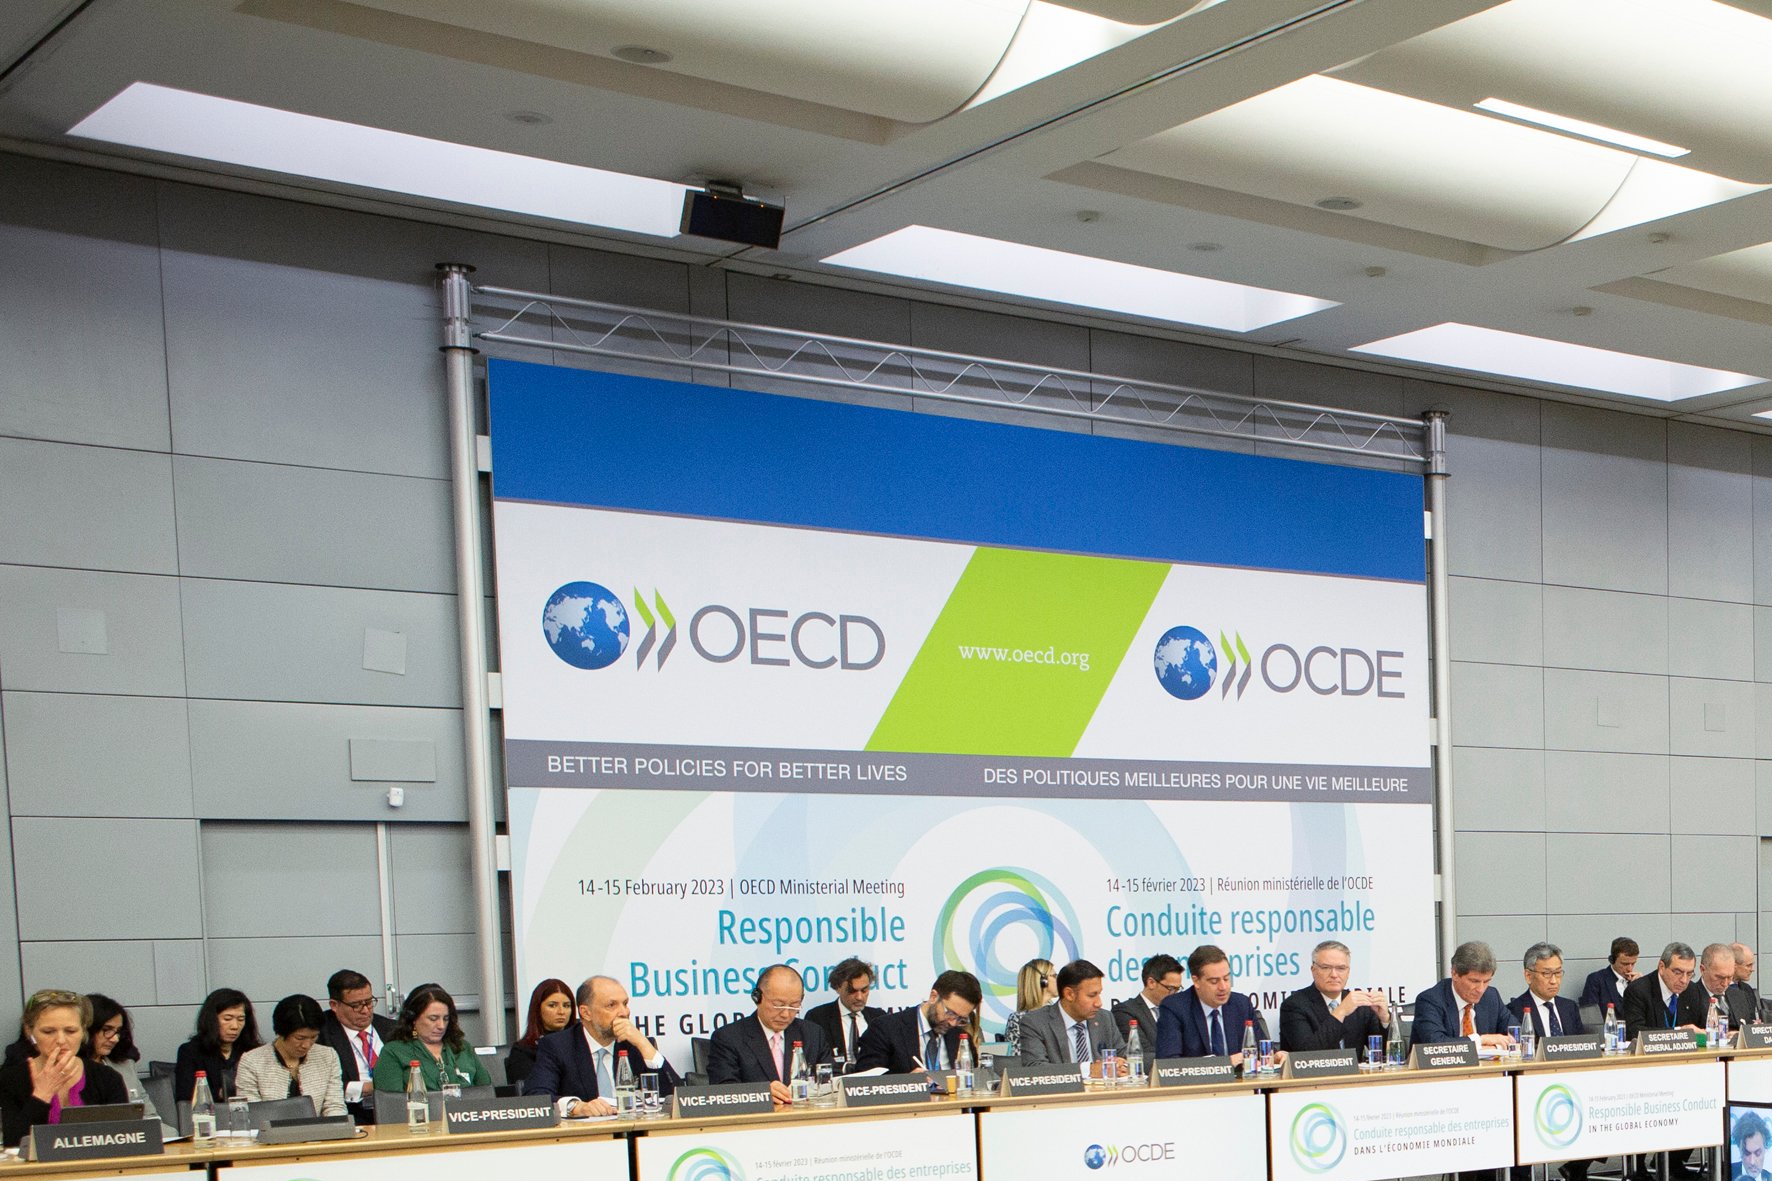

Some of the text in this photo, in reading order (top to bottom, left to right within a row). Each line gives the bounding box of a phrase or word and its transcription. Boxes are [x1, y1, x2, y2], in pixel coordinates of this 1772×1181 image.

[689, 604, 885, 671] OECD
[959, 645, 1090, 671] www.oecd.org
[1261, 643, 1405, 699] OCDE
[548, 755, 907, 781] BETTER POLICIES FOR BETTER LIVES
[984, 768, 1408, 792] DES POLITIQUES MEILLEURES POUR UNE VIE MEILLEURE
[626, 879, 687, 899] February
[692, 879, 724, 895] 2023
[739, 879, 776, 895] OECD
[780, 878, 849, 896] Ministerial
[853, 879, 905, 898] Meeting
[1141, 877, 1176, 893] février
[1180, 877, 1205, 892] 2023
[1217, 875, 1260, 892] Réunion
[1263, 875, 1324, 891] ministérielle
[1327, 875, 1339, 890] de
[719, 907, 906, 954] Responsible
[1107, 899, 1375, 943] Conduite responsable
[630, 959, 766, 997] Busines
[1648, 1032, 1689, 1041] SECRETAIRE
[1423, 1044, 1469, 1055] SECRETAIRE
[1547, 1042, 1597, 1053] CO-PRESIDENT
[1644, 1042, 1697, 1052] GENERAL ADJOINT
[1294, 1057, 1353, 1069] CO-PRESIDENT
[1430, 1056, 1466, 1066] GENERAL
[1009, 1072, 1082, 1088] VICE-PRESIDENT
[1158, 1064, 1233, 1080] VICE-PRESIDENT
[680, 1092, 771, 1108] VICE-PRESIDENT
[845, 1082, 928, 1099] VICE-PRESIDENT
[448, 1106, 551, 1124] VICE-PRESIDENT
[1589, 1098, 1716, 1119] Responsible Business Conduct
[1354, 1118, 1509, 1140] Conduite responsable des entreprises
[1589, 1118, 1678, 1133] IN THE GLOBAL ECONOMY
[52, 1130, 146, 1149] ALLEMAGNE
[1354, 1146, 1376, 1155] DANS
[1434, 1136, 1475, 1148] MONDIALE
[1122, 1142, 1176, 1162] OCDE
[794, 1158, 808, 1166] 2023
[887, 1166, 906, 1180] des
[910, 1161, 971, 1179] entreprises
